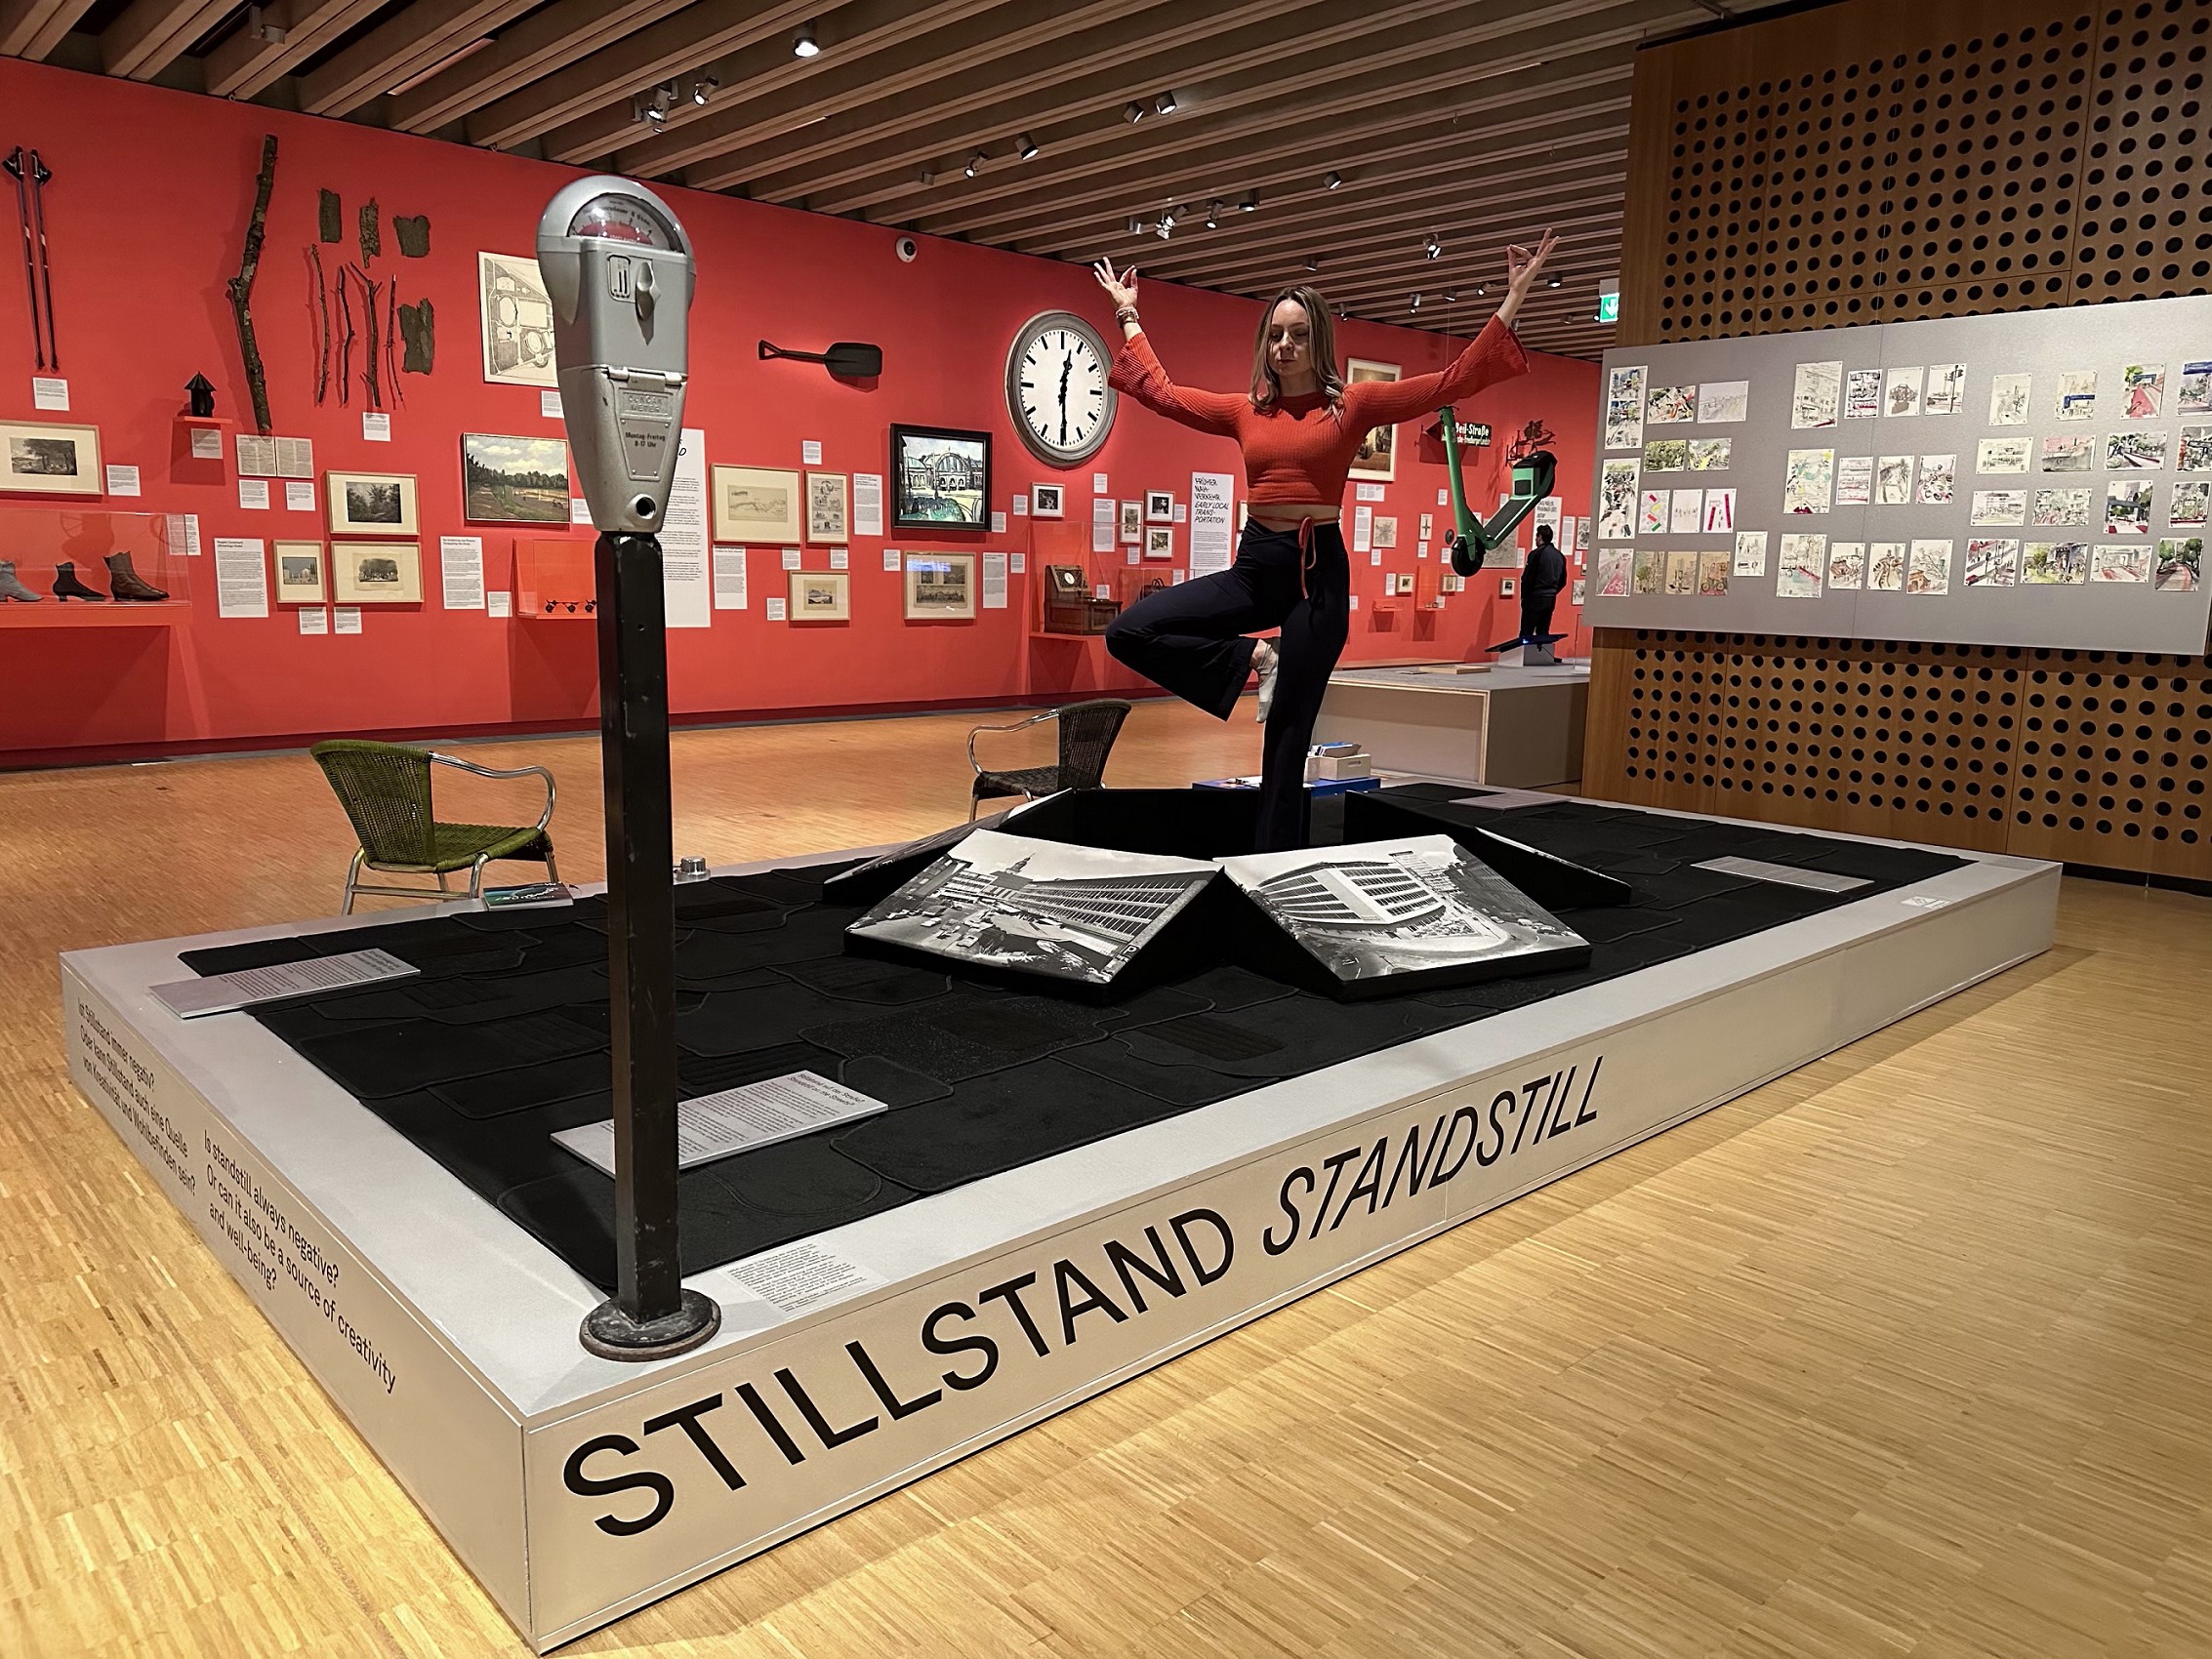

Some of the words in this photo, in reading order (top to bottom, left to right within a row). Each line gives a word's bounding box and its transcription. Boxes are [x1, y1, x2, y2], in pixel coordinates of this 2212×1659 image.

[80, 1025, 94, 1051] Oder
[93, 1038, 106, 1067] kann
[106, 1053, 135, 1098] Stillstand
[134, 1088, 150, 1116] auch
[150, 1104, 165, 1132] eine
[165, 1117, 188, 1159] Quelle
[85, 1005, 111, 1046] Stillstand
[110, 1030, 129, 1065] immer
[129, 1055, 155, 1093] negativ?
[83, 1055, 93, 1072] von
[92, 1061, 122, 1109] Kreativität
[121, 1099, 133, 1122] und
[132, 1108, 179, 1176] Wohlbefinden
[178, 1168, 197, 1196] sein?
[1263, 1055, 1604, 1256] STANDSTILL
[204, 1129, 211, 1153] Is
[212, 1143, 252, 1198] standstill
[254, 1186, 286, 1234] always
[288, 1222, 339, 1288] negative?
[206, 1163, 218, 1191] Or
[218, 1181, 233, 1210] can
[234, 1194, 242, 1220] it
[243, 1208, 263, 1241] also
[264, 1225, 276, 1257] be
[277, 1247, 284, 1268] a
[286, 1255, 321, 1307] source
[323, 1298, 337, 1322] of
[338, 1315, 396, 1395] creativity
[209, 1202, 225, 1231] and
[225, 1220, 277, 1291] well-being?
[562, 1207, 1236, 1538] STILLSTAND
